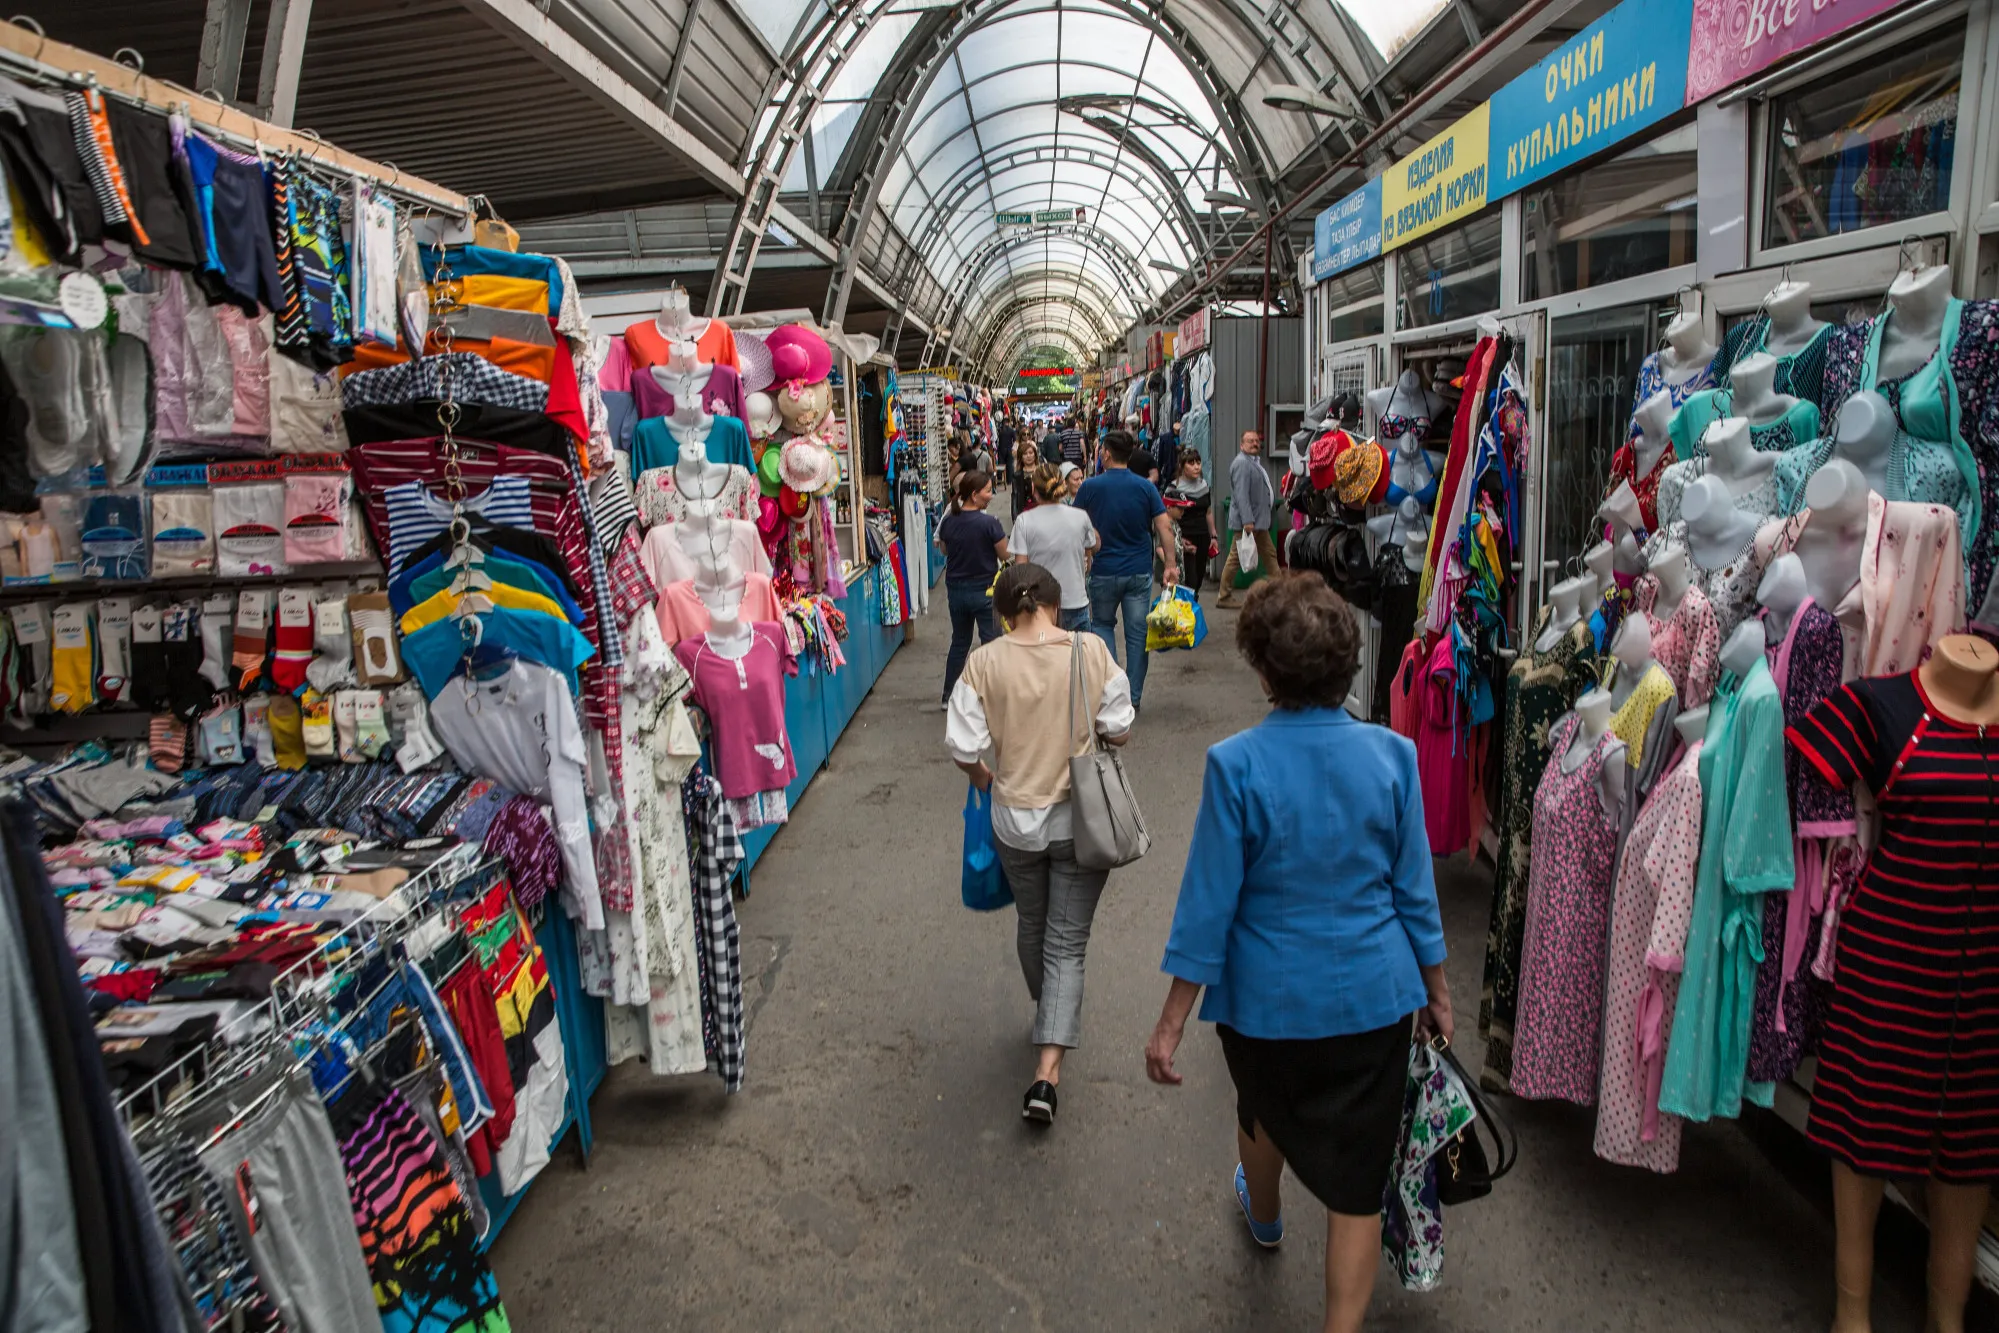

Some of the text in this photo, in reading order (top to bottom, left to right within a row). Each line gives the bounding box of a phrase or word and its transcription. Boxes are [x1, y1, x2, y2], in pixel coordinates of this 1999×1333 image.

[1545, 30, 1604, 103] ОЧКИ
[1506, 61, 1656, 180] КУПАЛЬНИКИ
[1407, 136, 1454, 192] ИЗДЕЛИЯ
[1037, 210, 1071, 222] ВЫХОД
[1329, 208, 1341, 226] БАС
[1384, 163, 1485, 243] ИЗ ВЯЗАНОЙ НОРКИ
[1331, 228, 1345, 246] ТАЗА
